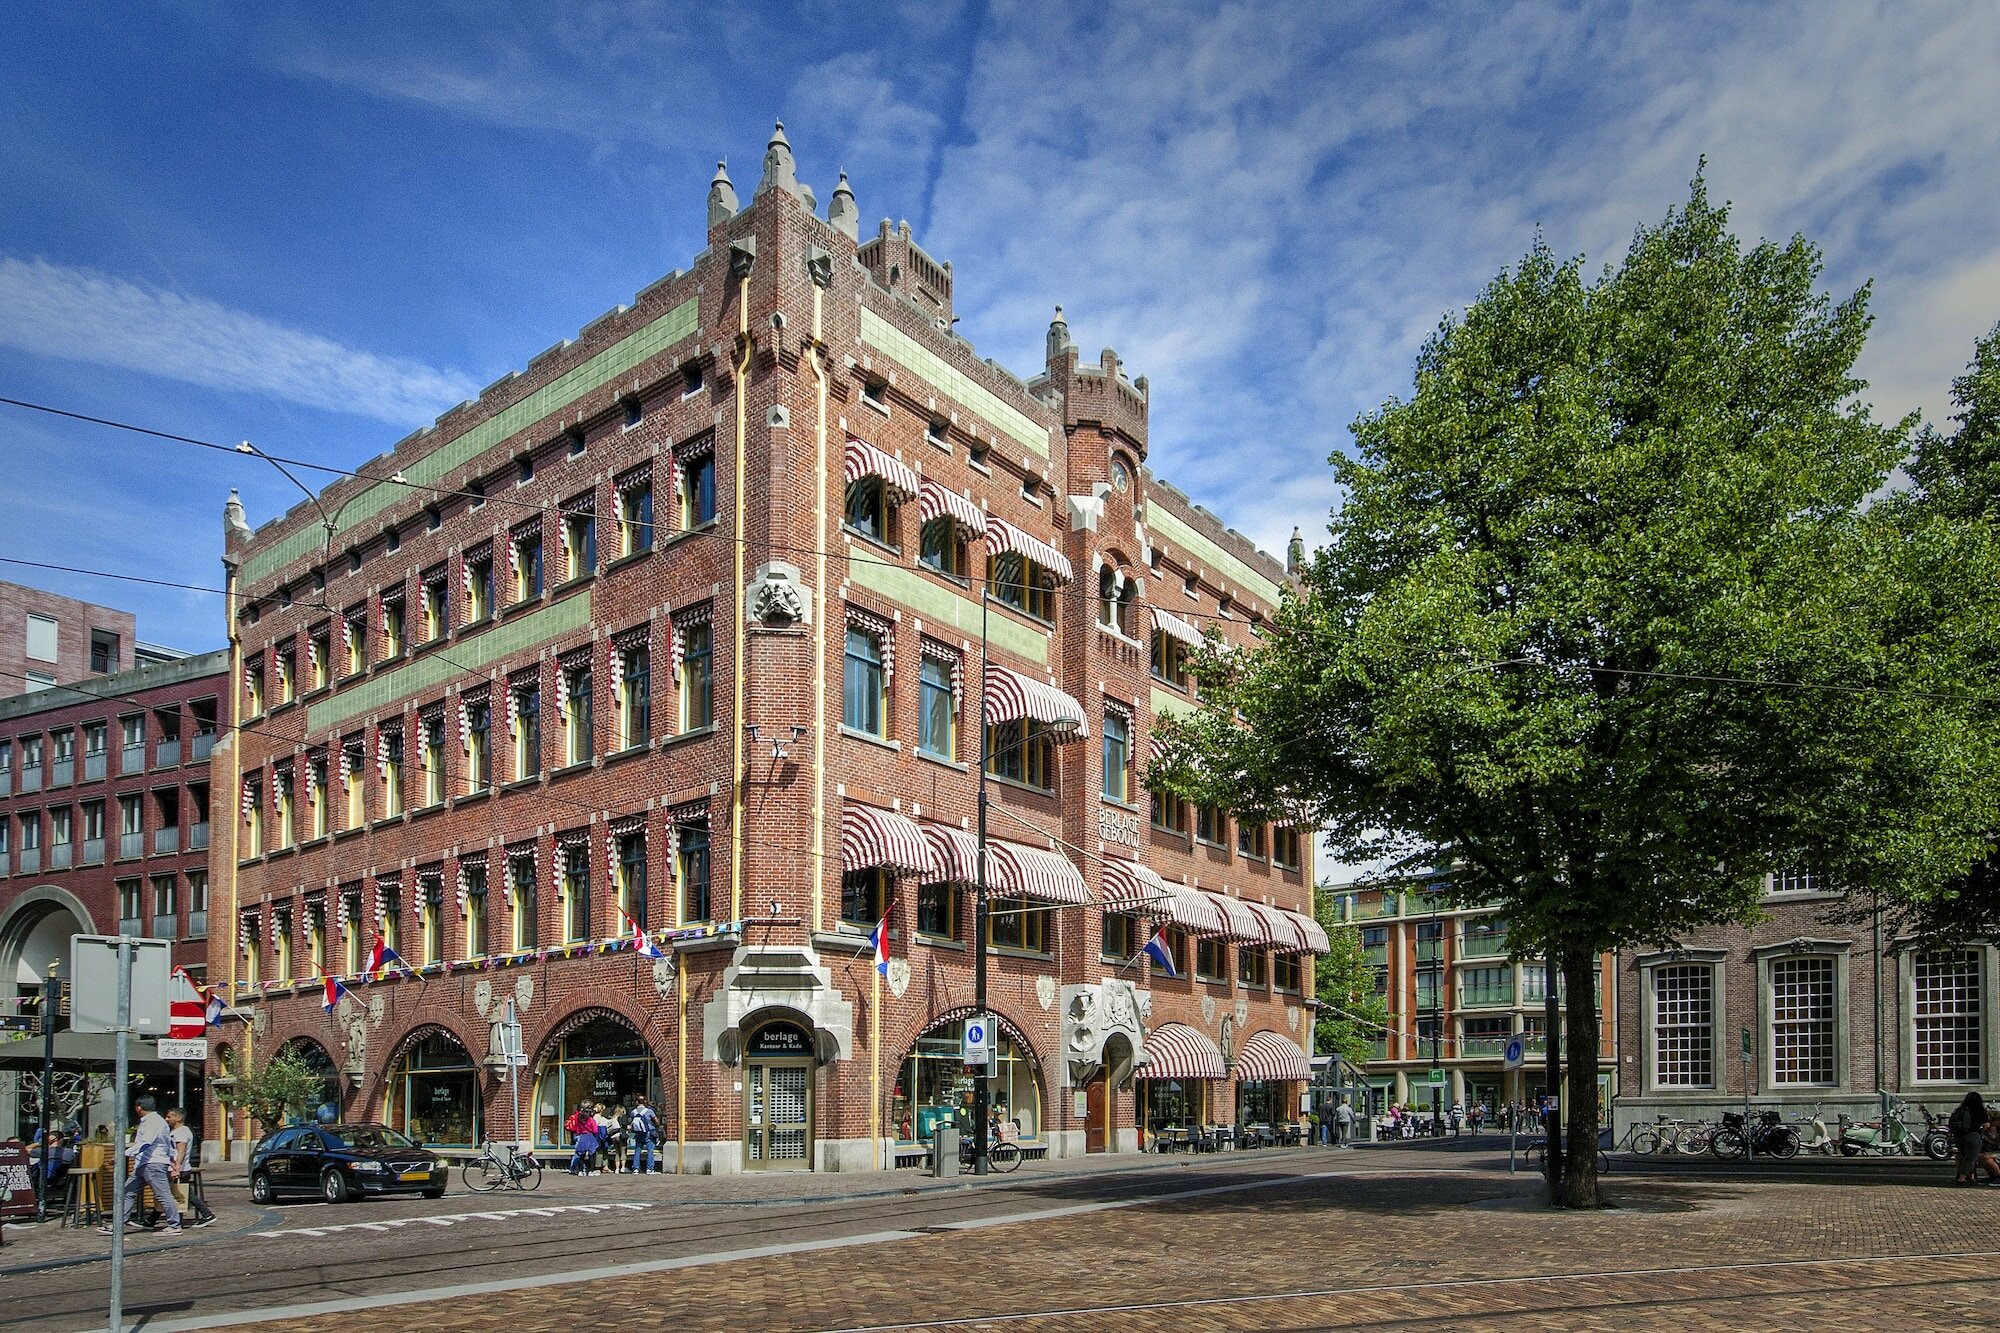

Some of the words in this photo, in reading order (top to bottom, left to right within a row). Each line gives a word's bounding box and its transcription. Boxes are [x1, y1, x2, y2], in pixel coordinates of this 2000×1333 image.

[1099, 807, 1140, 833] BERLAGE
[1098, 823, 1140, 848] GEBOUW
[764, 1031, 798, 1043] berlage
[595, 1079, 615, 1090] berlage
